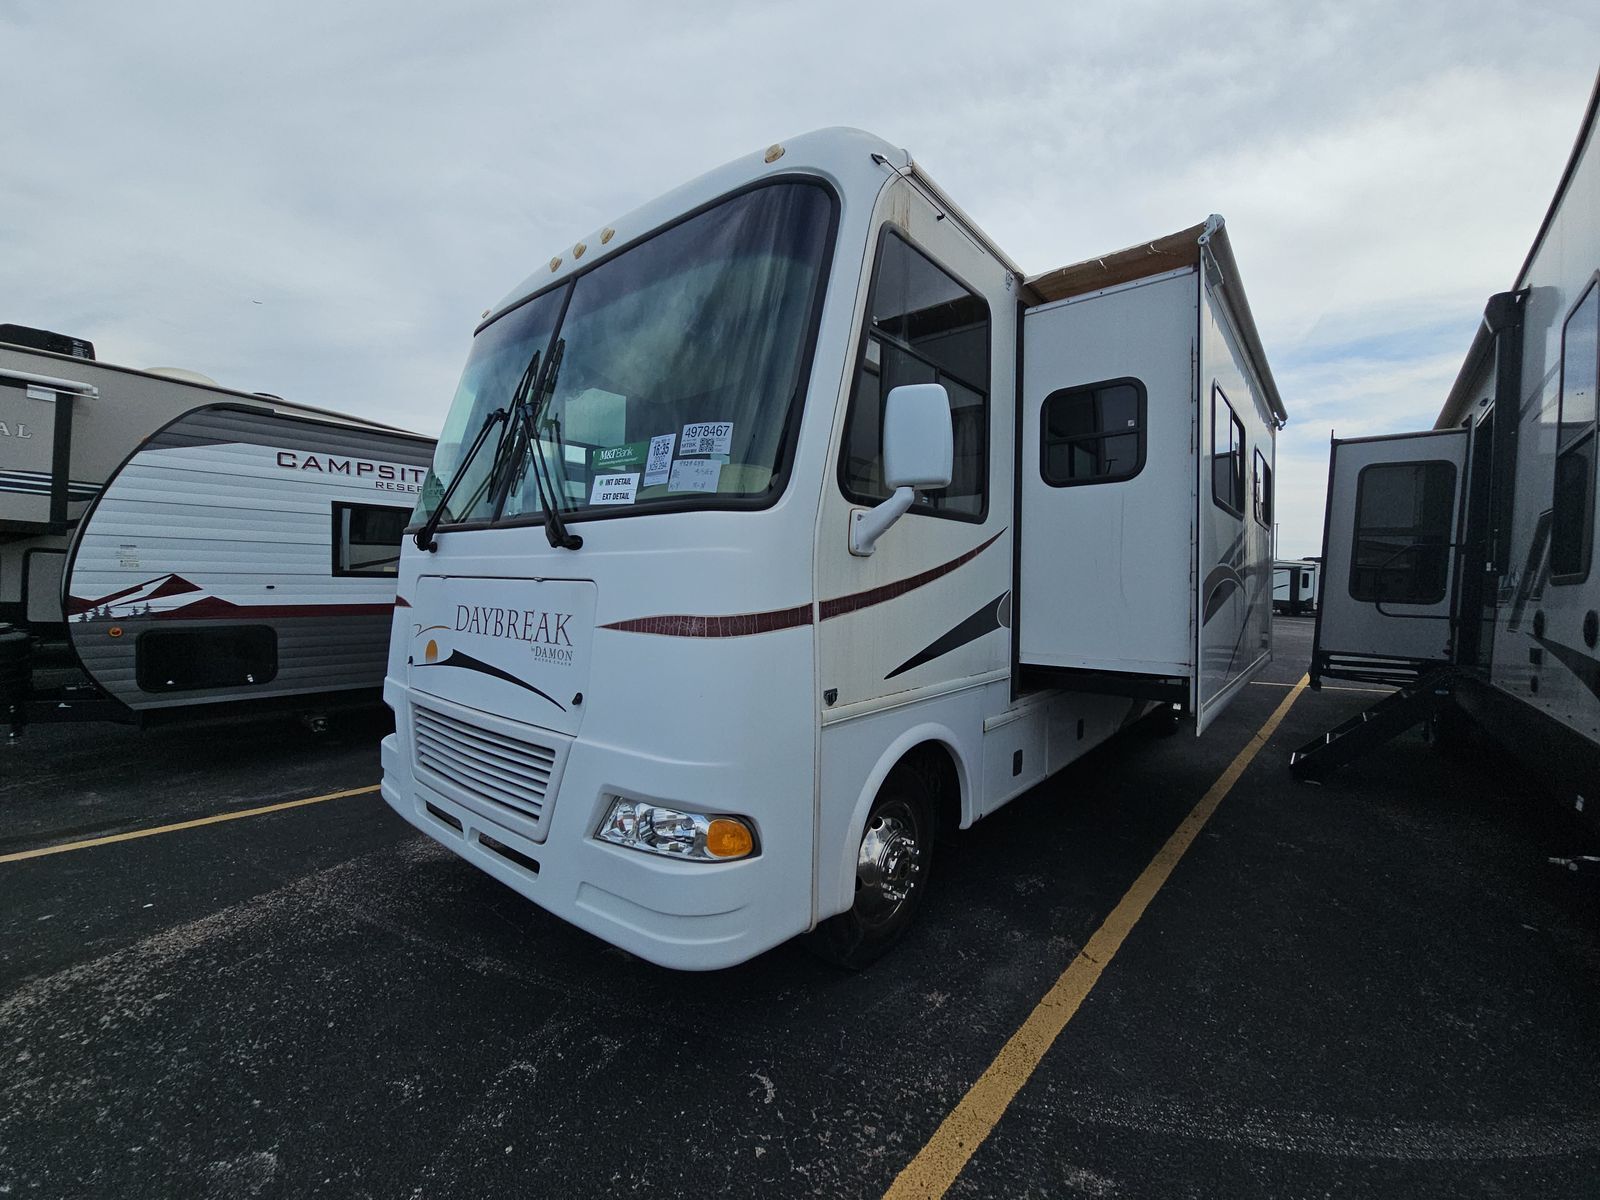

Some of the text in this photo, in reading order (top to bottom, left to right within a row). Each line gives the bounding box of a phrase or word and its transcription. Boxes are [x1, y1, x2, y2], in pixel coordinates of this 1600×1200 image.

[685, 425, 730, 438] 4978467
[600, 447, 634, 460] M&T Bank
[612, 492, 630, 500] DETAIL
[455, 604, 574, 647] DAYBREAK
[534, 645, 573, 661] DAMON
